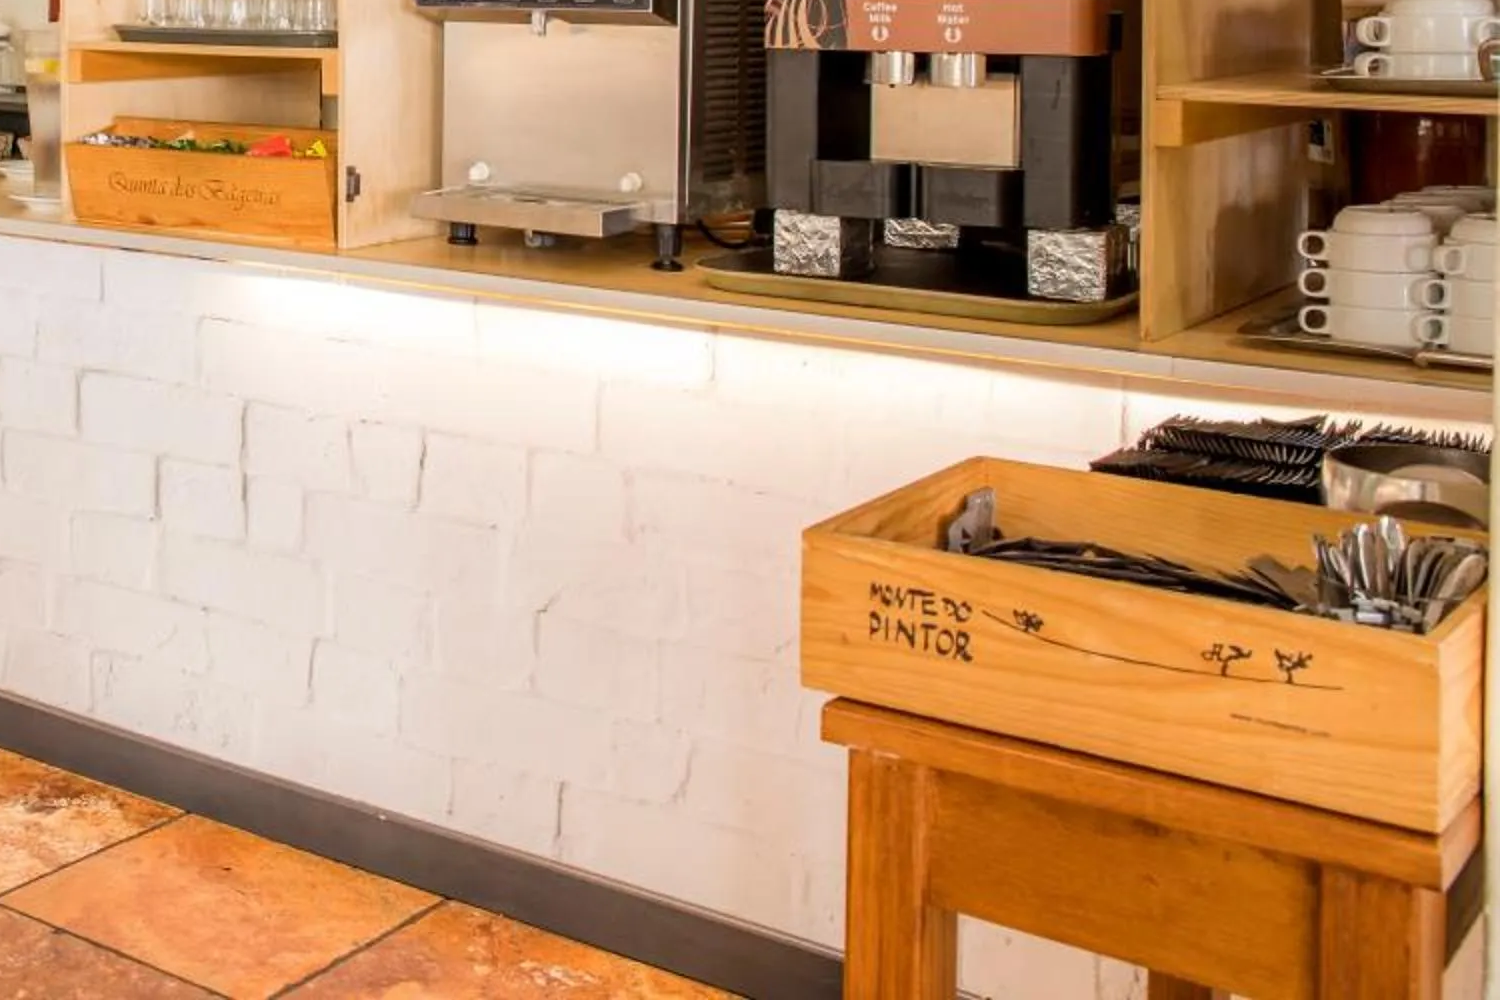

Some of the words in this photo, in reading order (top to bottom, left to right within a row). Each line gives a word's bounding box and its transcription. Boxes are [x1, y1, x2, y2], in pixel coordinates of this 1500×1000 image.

[863, 1, 898, 13] Coffee
[108, 171, 167, 196] Quinta
[869, 582, 938, 617] MONTE
[941, 596, 973, 623] DO
[868, 610, 974, 663] PINTOR
